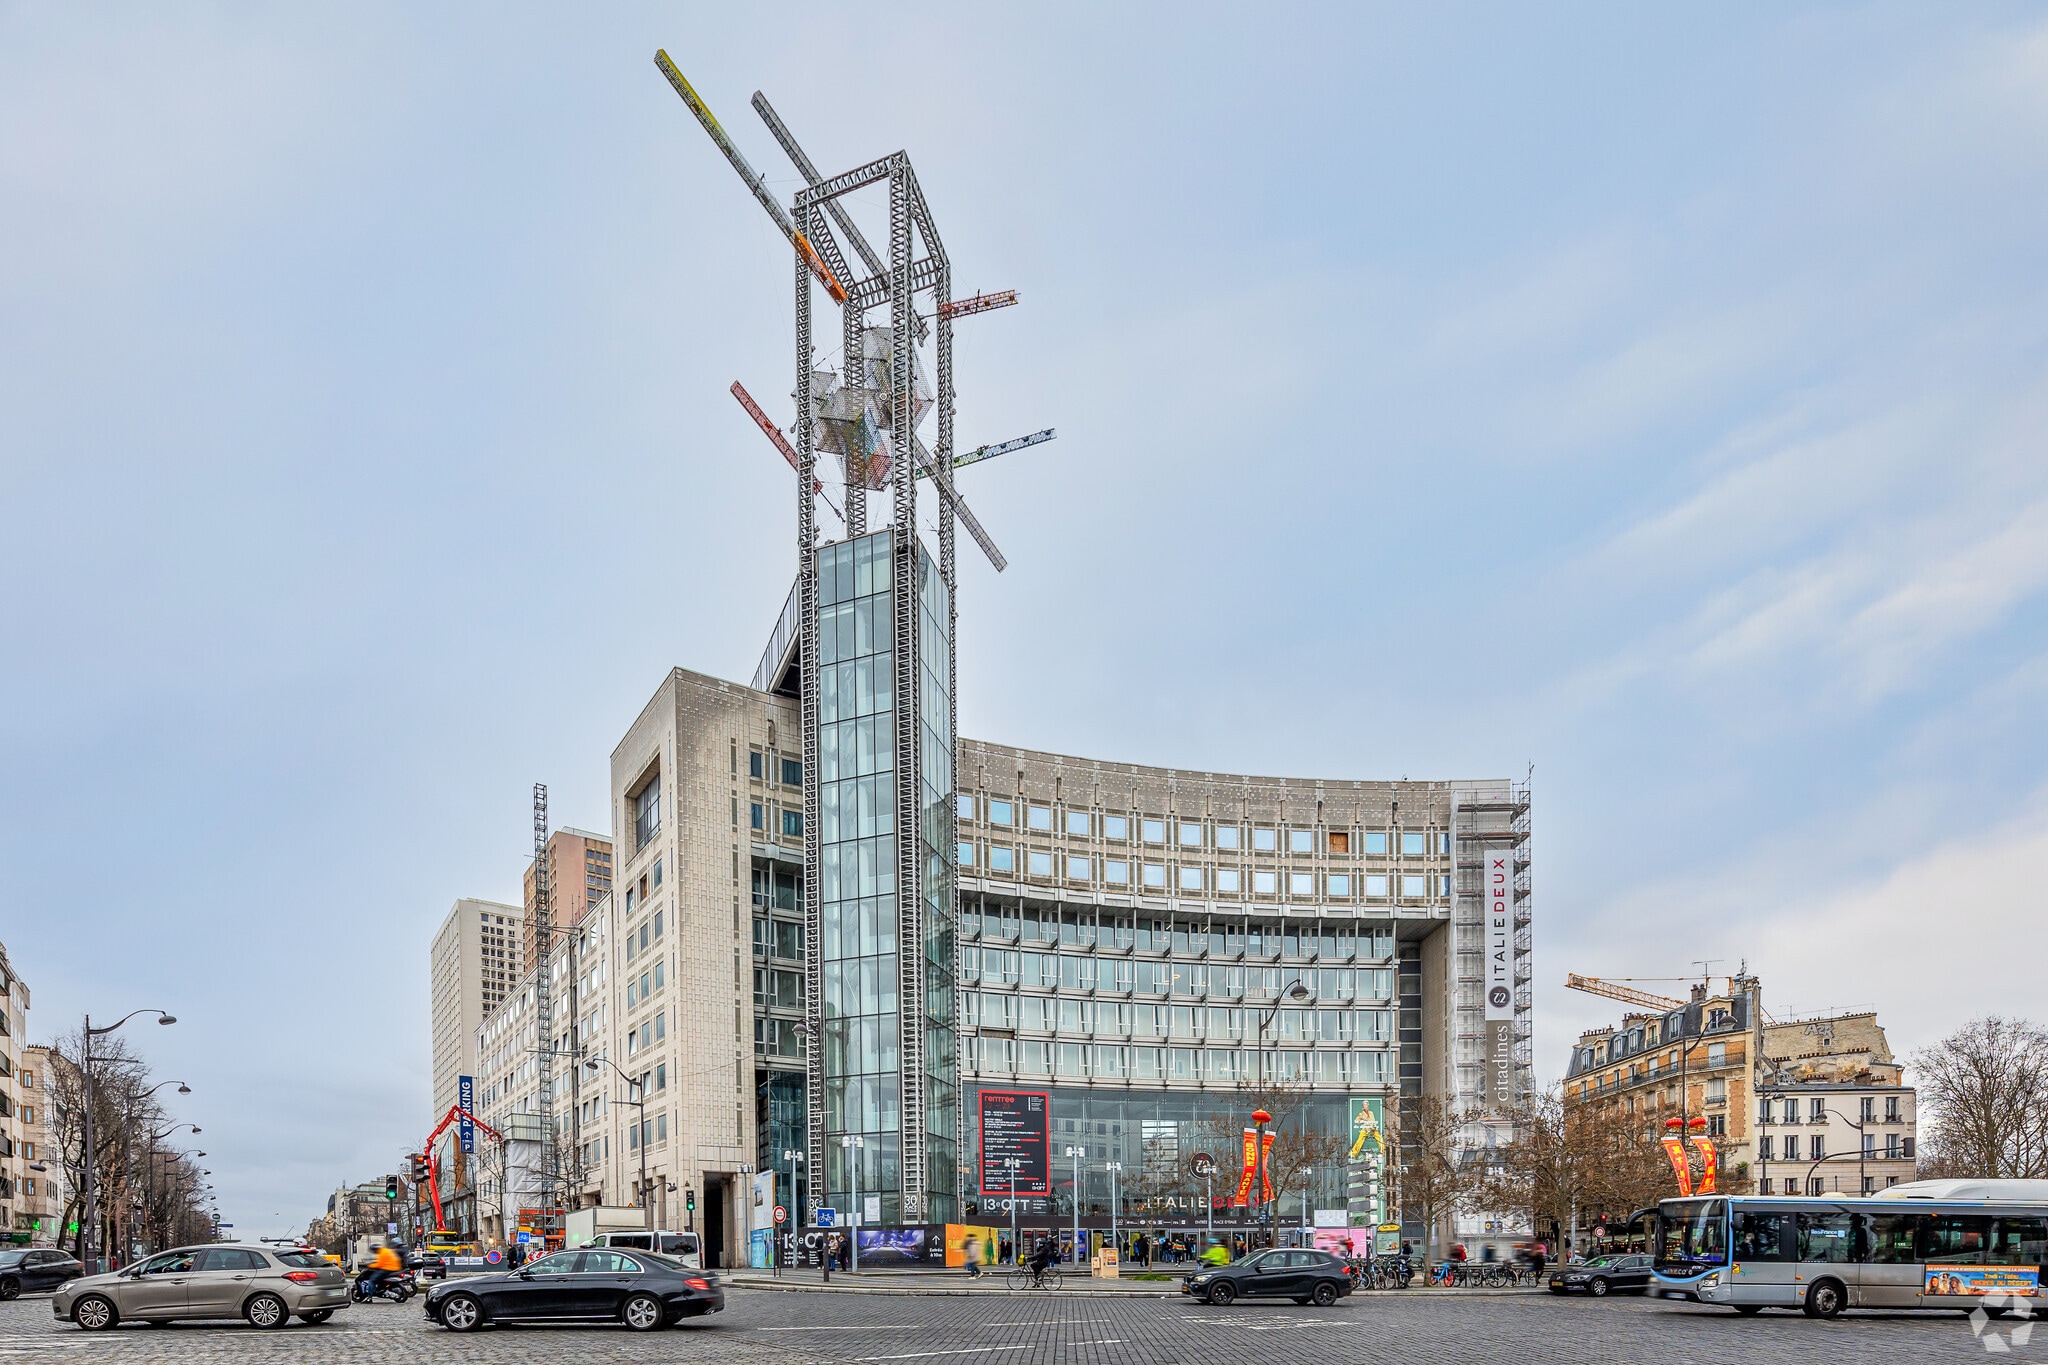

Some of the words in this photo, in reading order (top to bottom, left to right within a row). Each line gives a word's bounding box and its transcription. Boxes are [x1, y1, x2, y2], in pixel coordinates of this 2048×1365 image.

[1494, 858, 1505, 912] DEUX
[1494, 918, 1505, 981] ITALIE
[1492, 1025, 1508, 1101] citadines
[1245, 1142, 1255, 1167] BONNE
[904, 1195, 917, 1206] 30
[1147, 1196, 1208, 1208] ITALIE
